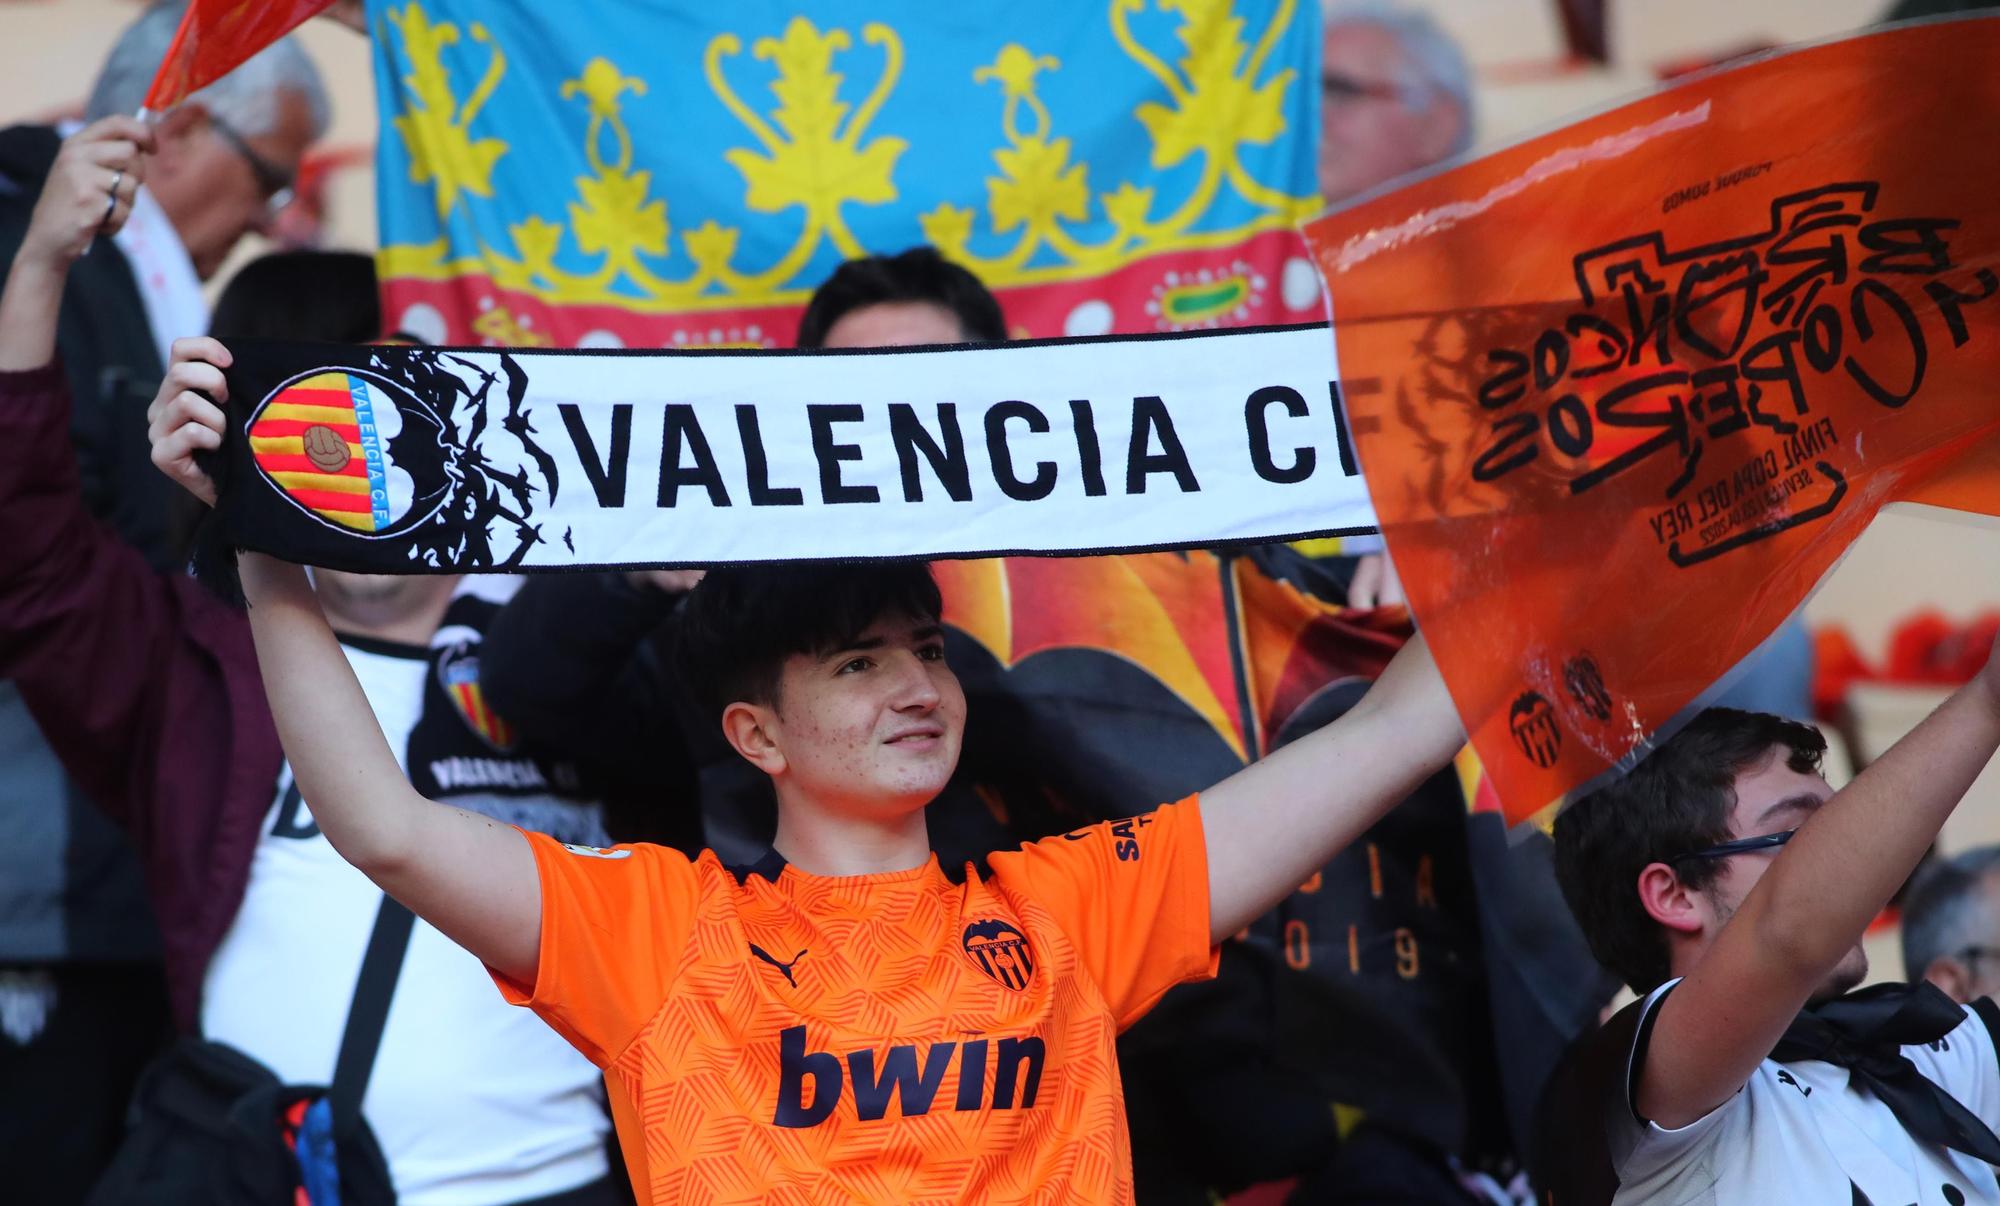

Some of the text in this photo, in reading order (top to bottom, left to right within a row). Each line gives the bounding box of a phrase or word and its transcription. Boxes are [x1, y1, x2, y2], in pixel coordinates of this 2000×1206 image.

[353, 383, 384, 482] VALENCIA
[556, 377, 1384, 508] VALENCIA CF
[429, 756, 548, 790] VALENCIA
[968, 941, 1009, 952] VALENCIA
[772, 1024, 1046, 1129] bwin
